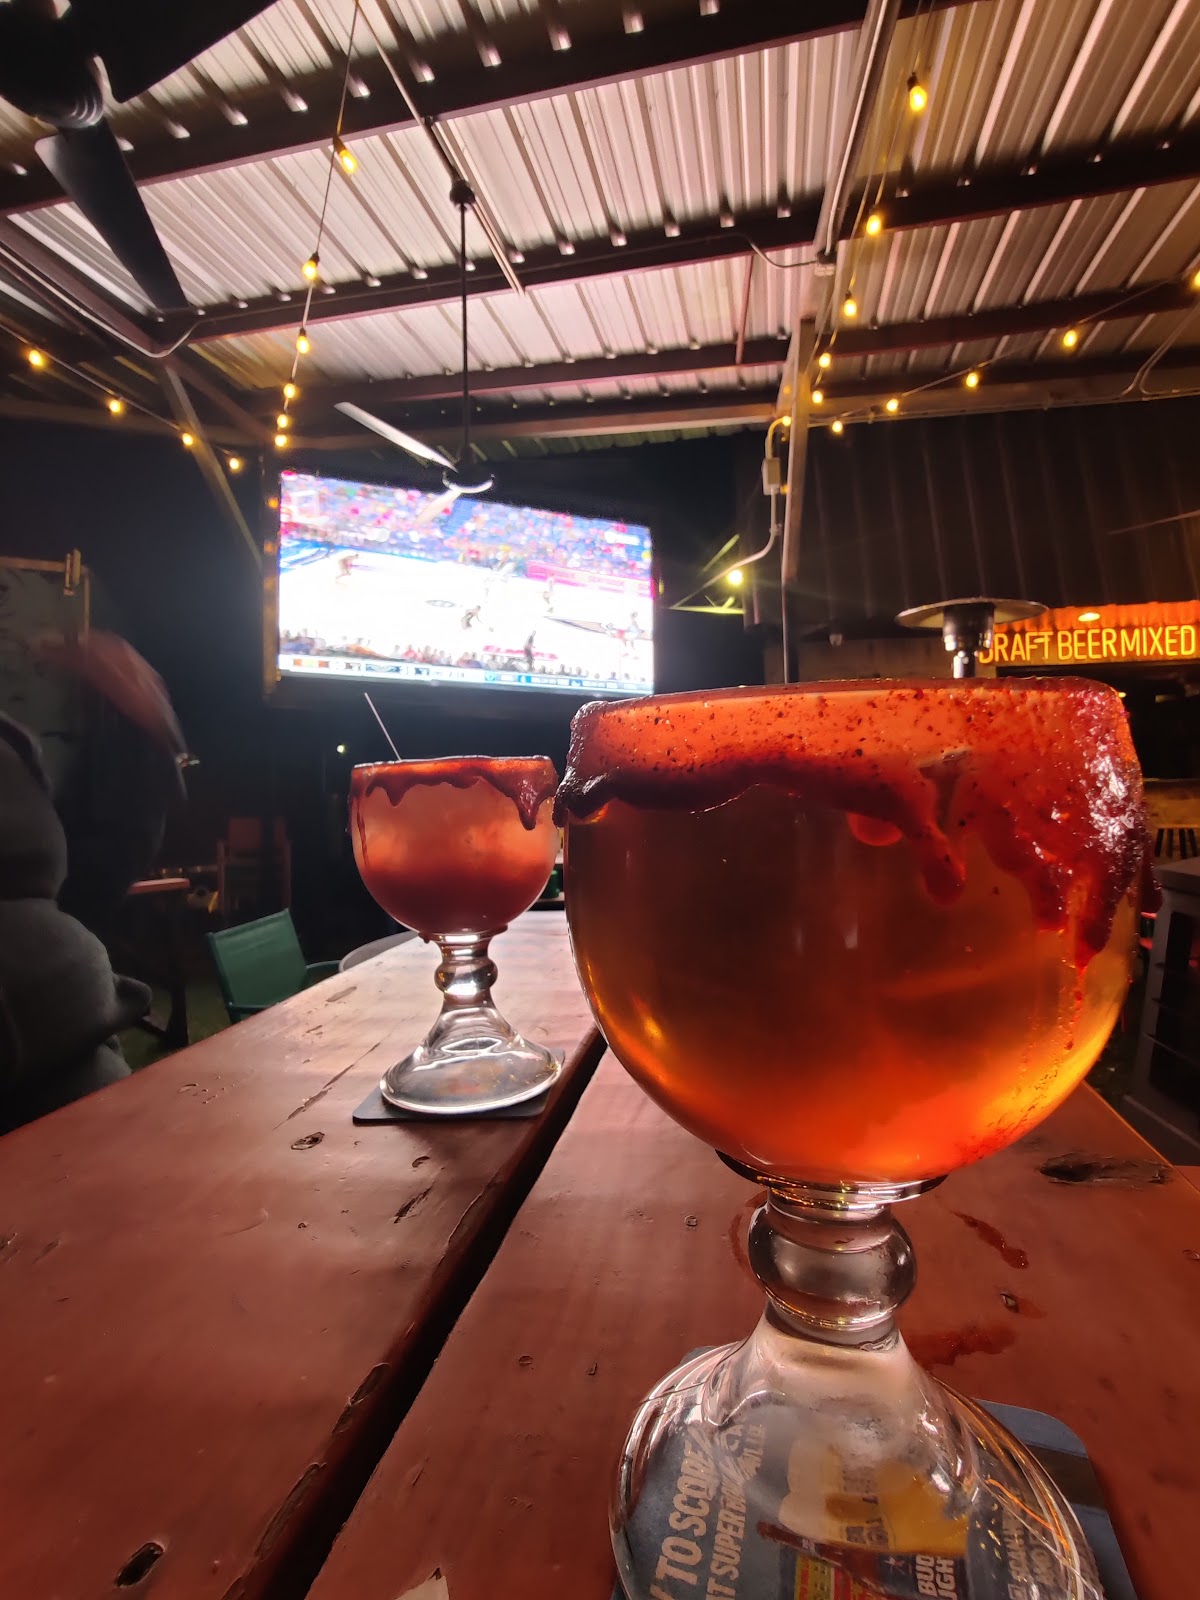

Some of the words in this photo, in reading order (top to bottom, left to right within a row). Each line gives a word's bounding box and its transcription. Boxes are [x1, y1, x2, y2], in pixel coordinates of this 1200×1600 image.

[1057, 627, 1117, 661] BEER
[1120, 624, 1197, 657] MIXED
[668, 1440, 717, 1537] SCORE
[655, 1536, 702, 1585] TO
[711, 1508, 747, 1581] SUPER
[915, 1555, 938, 1597] BUD
